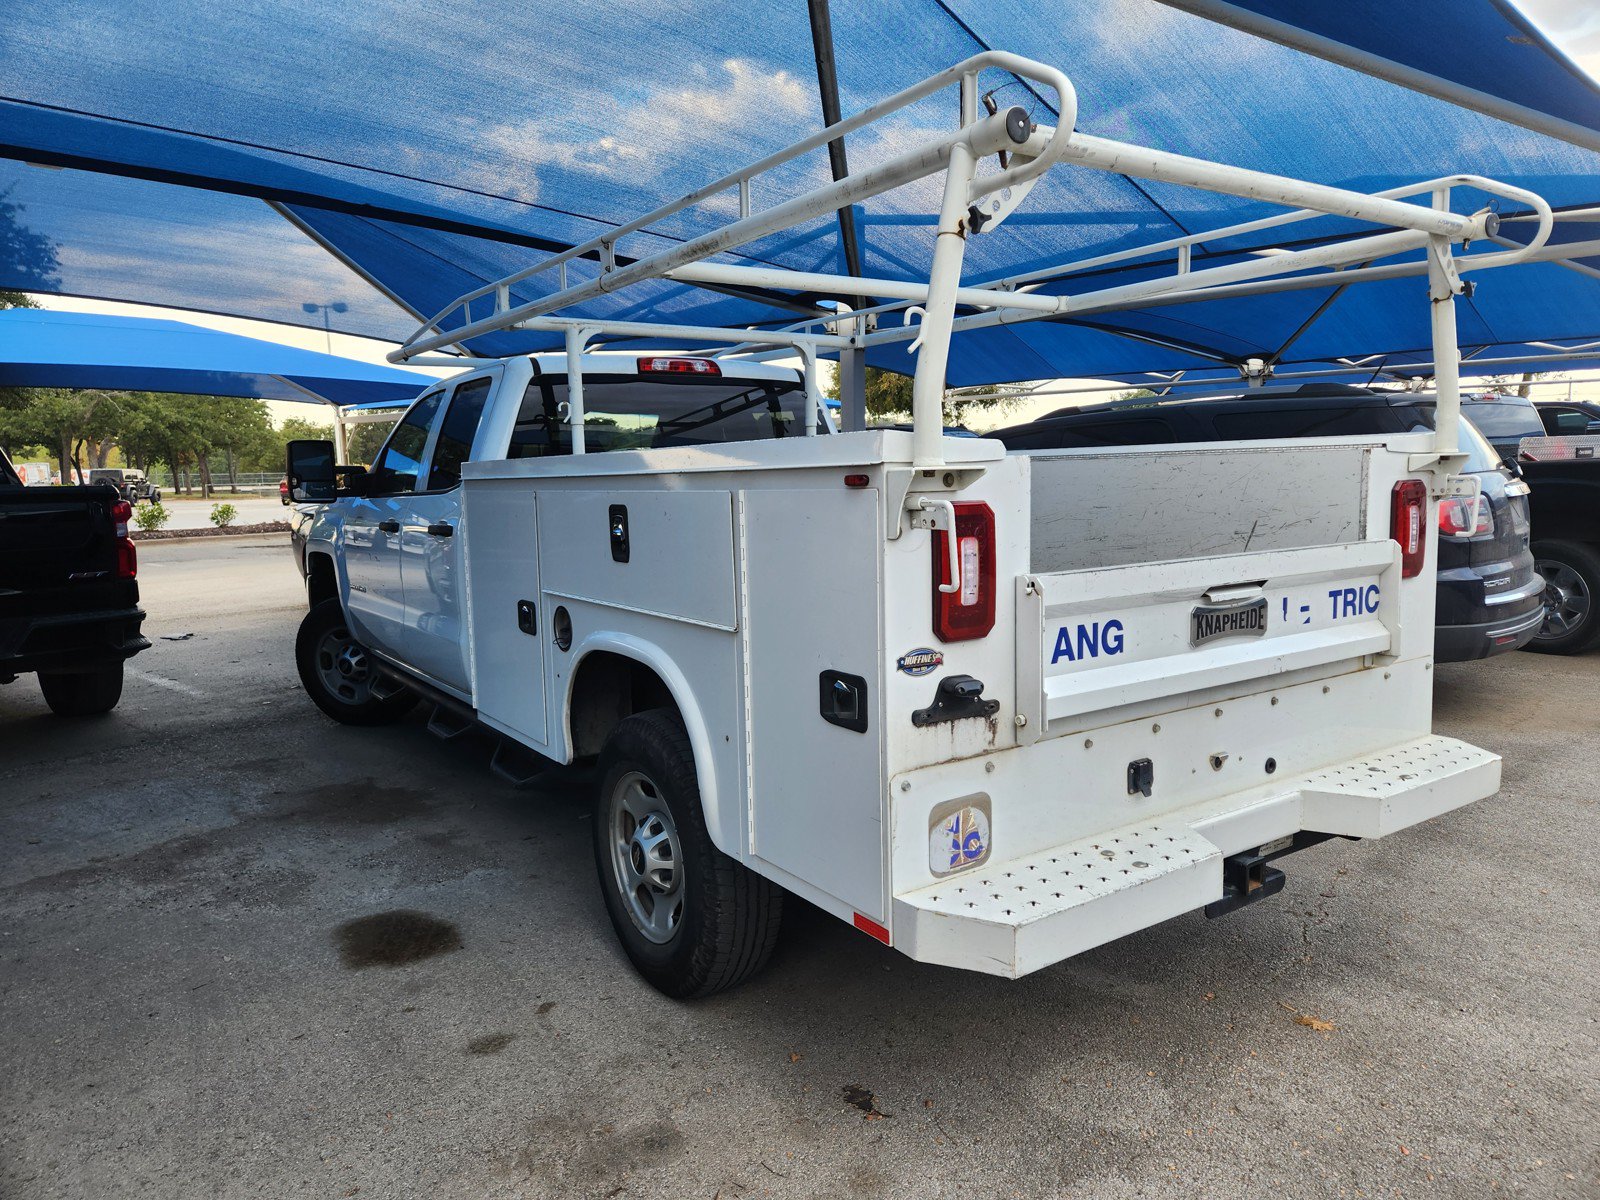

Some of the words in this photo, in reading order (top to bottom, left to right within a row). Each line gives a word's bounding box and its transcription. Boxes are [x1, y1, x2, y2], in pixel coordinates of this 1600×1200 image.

[1051, 620, 1125, 665] ANG
[1329, 584, 1381, 620] TRIC
[1196, 605, 1265, 640] KNAPHEIDE
